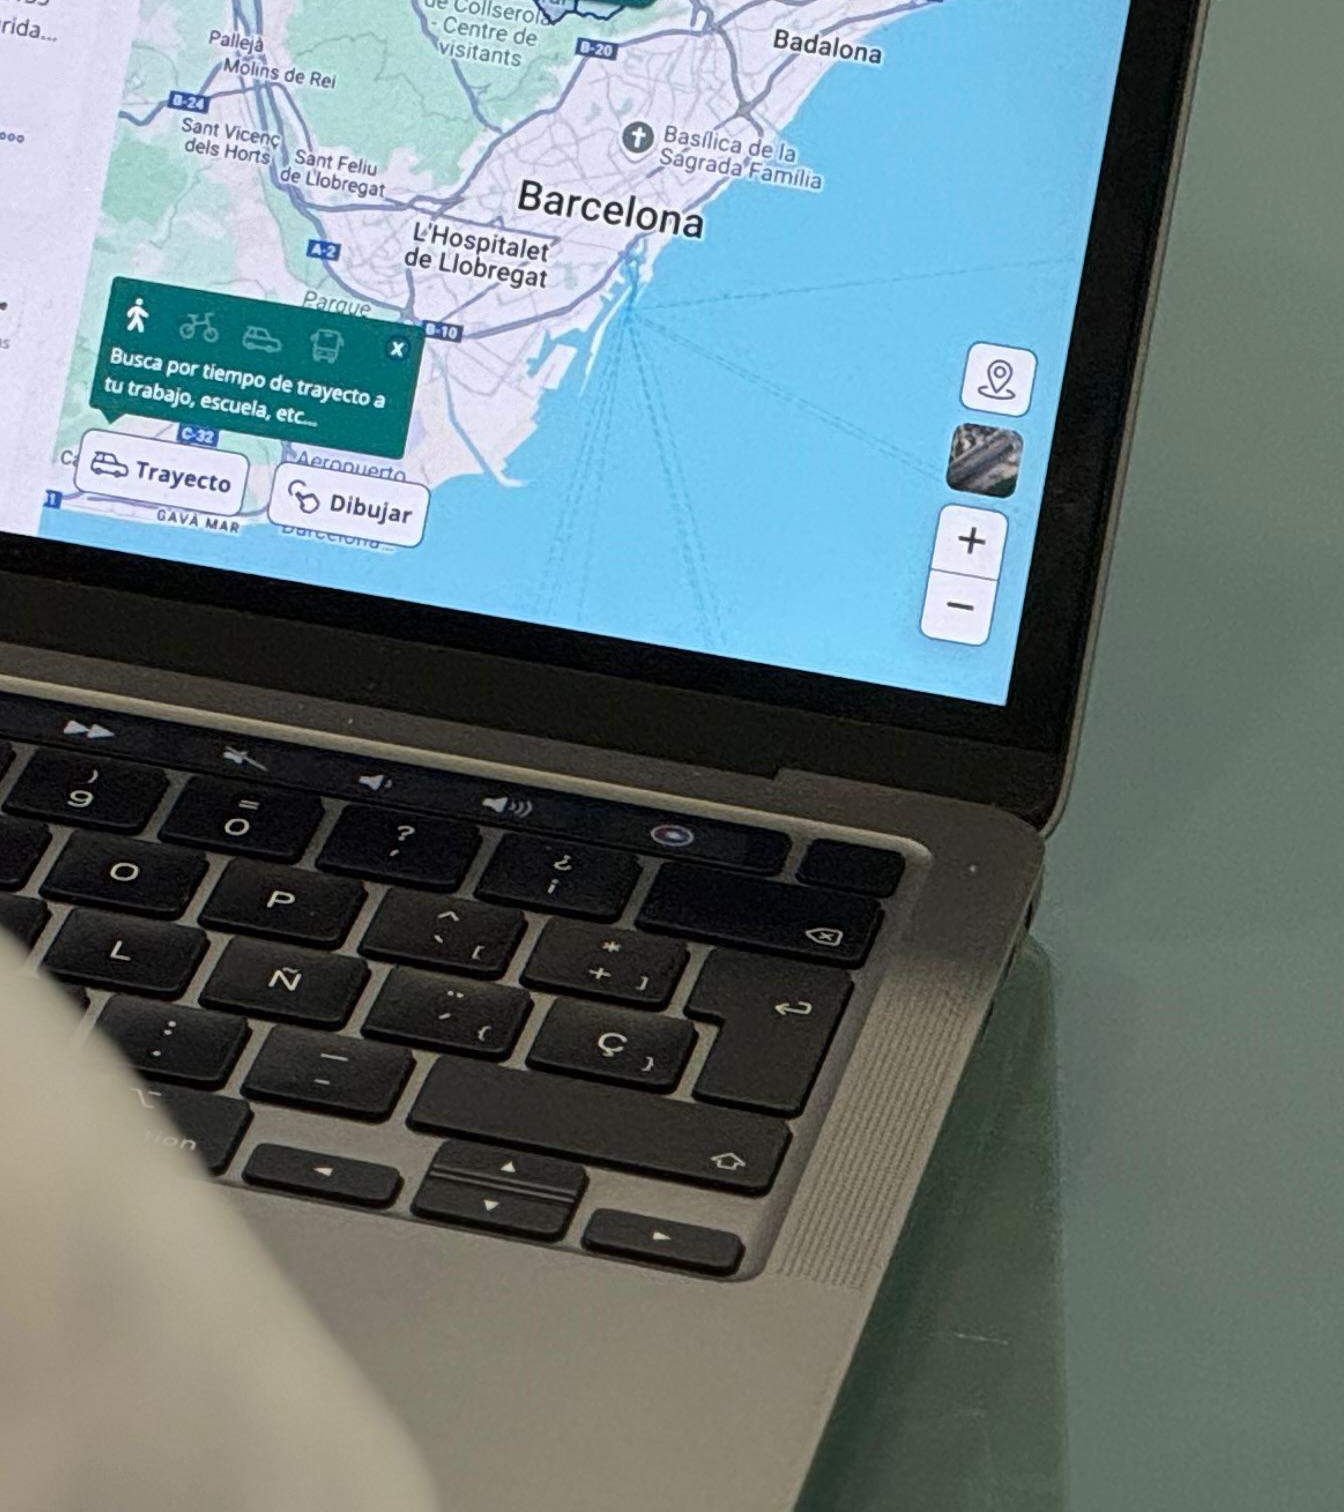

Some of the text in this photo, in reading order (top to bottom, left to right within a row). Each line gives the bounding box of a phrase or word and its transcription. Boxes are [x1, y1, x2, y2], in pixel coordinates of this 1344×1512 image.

[772, 27, 882, 64] Badalona
[663, 125, 796, 162] Basílica de la
[658, 149, 823, 191] Sagrada Família
[516, 178, 704, 239] Barcelona
[412, 221, 550, 265] L'Hospitalet
[403, 245, 548, 289] de Llobregat
[109, 345, 386, 409] Busca por tiempo de trayecto a
[103, 375, 124, 394] tu
[126, 379, 195, 409] trabajo,
[199, 394, 271, 421] escuela,
[135, 459, 232, 493] Trayecto
[329, 493, 413, 525] Dibujar
[67, 789, 94, 808] 9
[109, 862, 140, 882] O
[266, 890, 296, 908] P
[110, 940, 131, 961] L
[268, 967, 302, 991] Ñ
[597, 1032, 628, 1057] Ç
